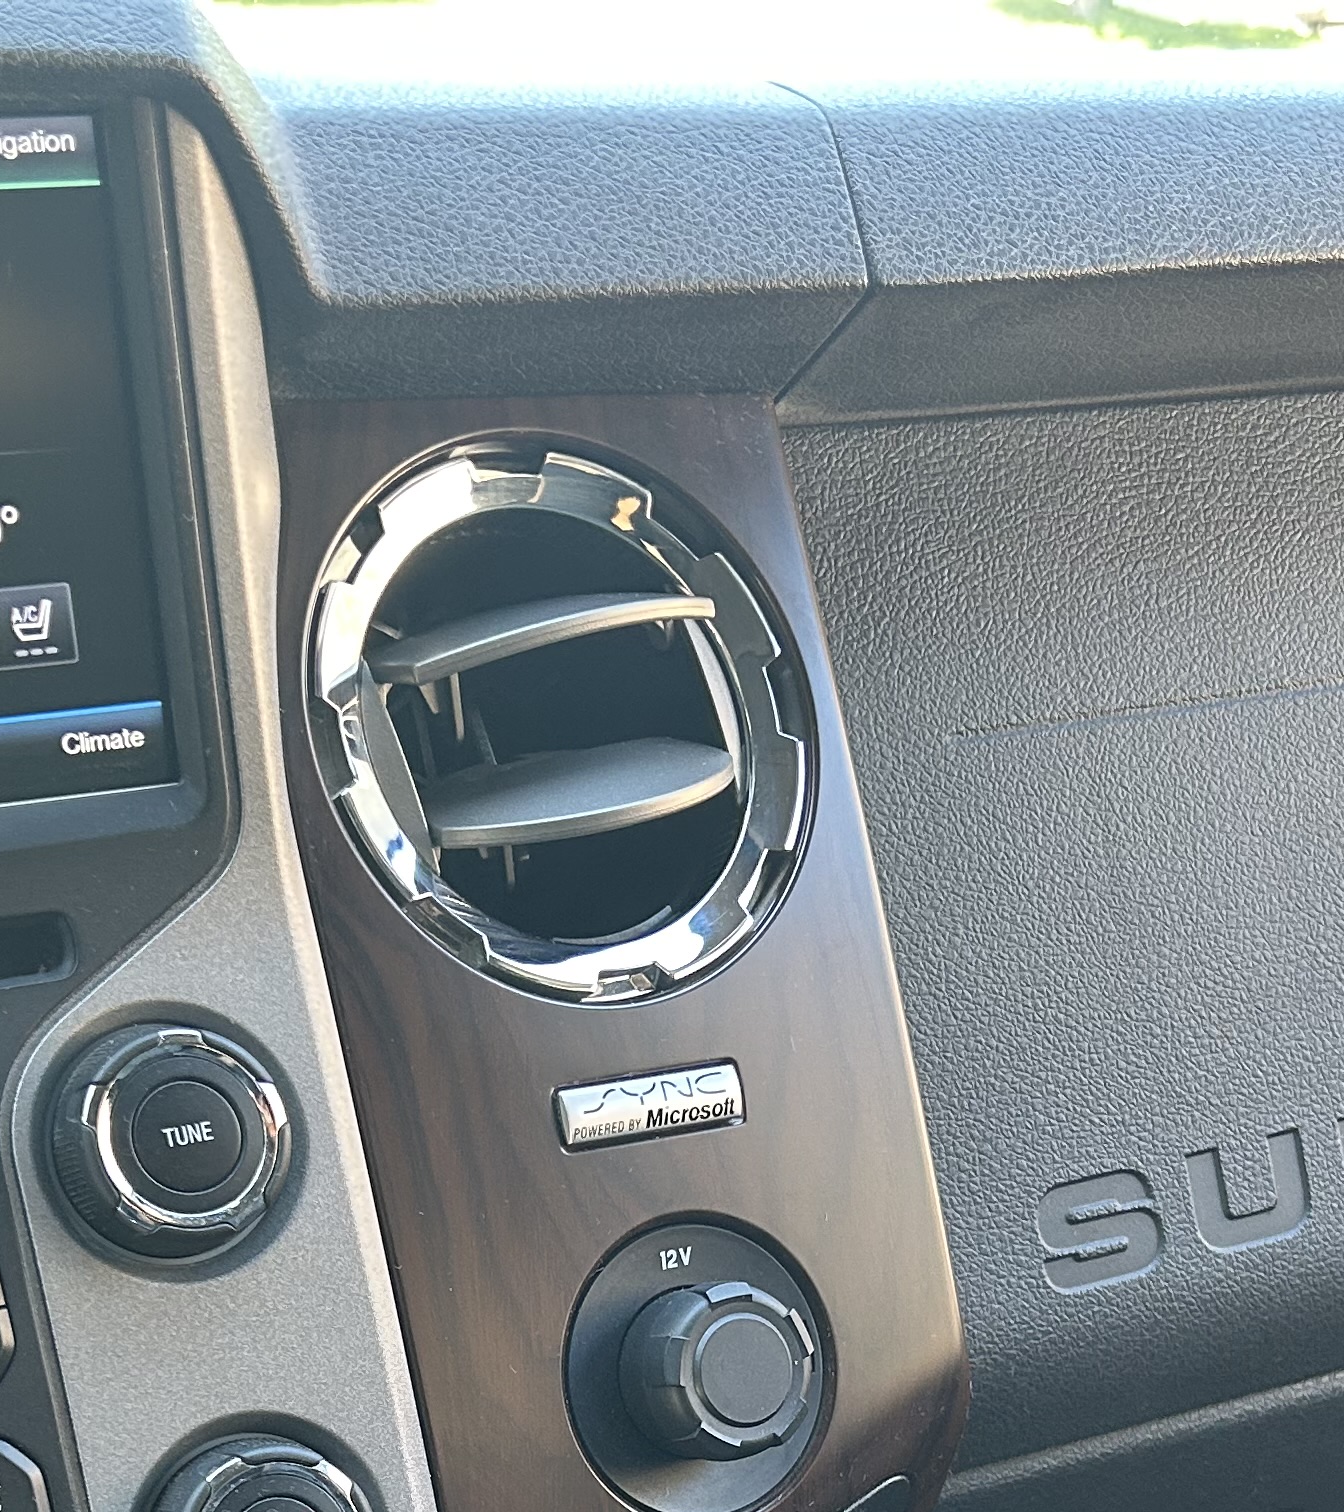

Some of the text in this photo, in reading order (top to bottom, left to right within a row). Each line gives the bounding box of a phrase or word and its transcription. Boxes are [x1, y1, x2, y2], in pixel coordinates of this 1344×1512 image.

[61, 727, 145, 757] Climate
[583, 1072, 727, 1114] SYNC
[573, 1097, 735, 1140] POWERED BY Microsoft
[162, 1121, 214, 1148] TUNE
[659, 1246, 692, 1271] 12V
